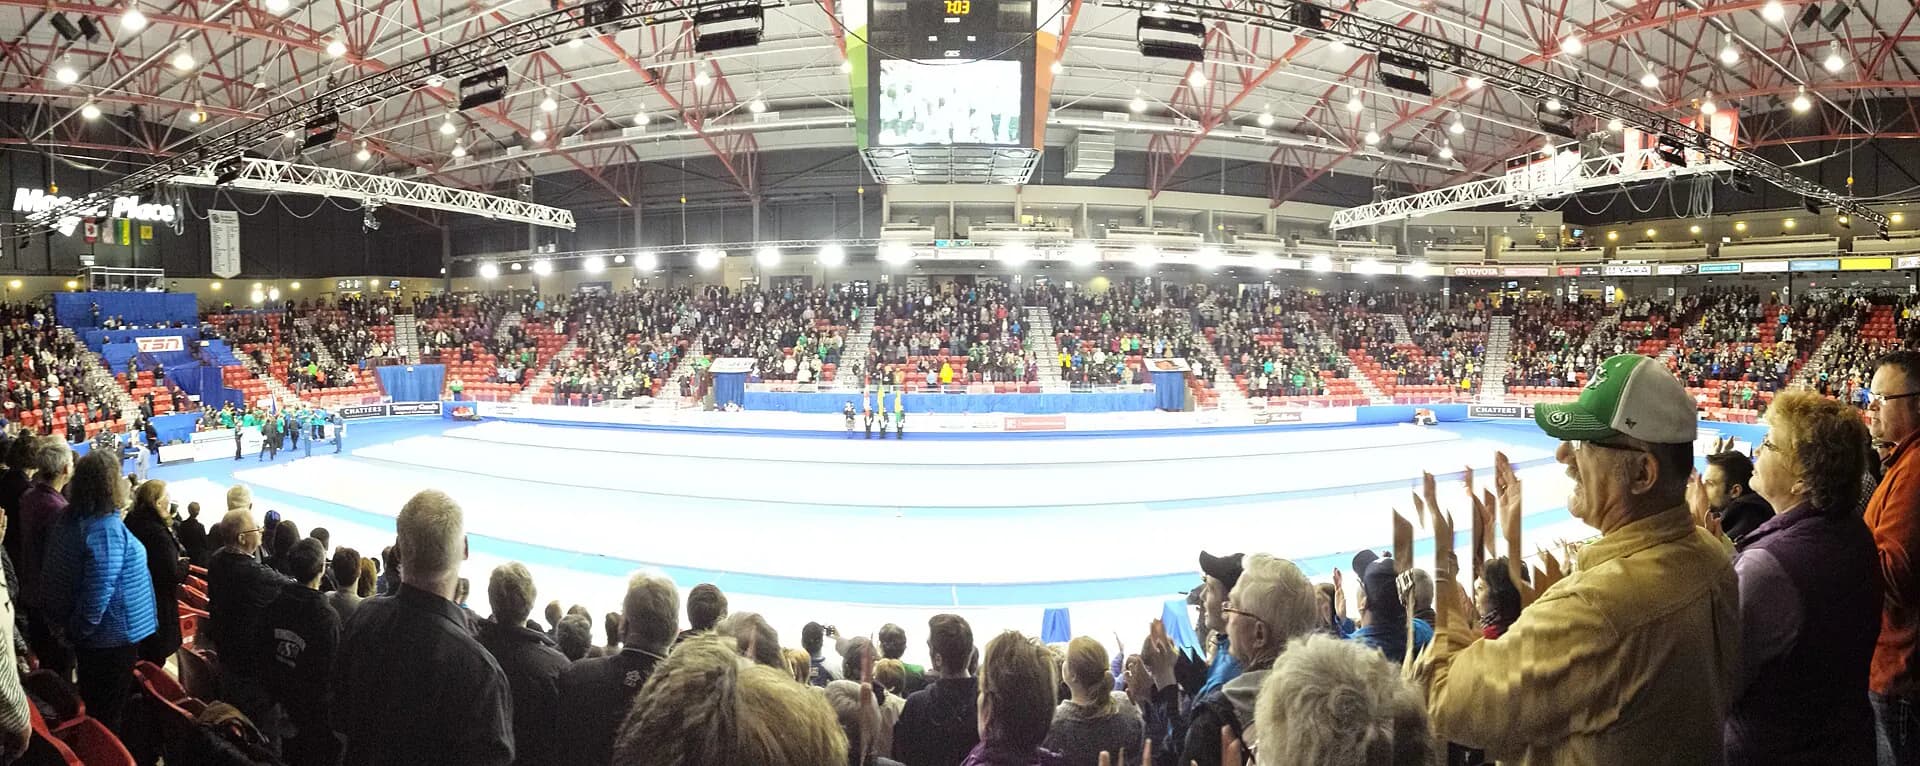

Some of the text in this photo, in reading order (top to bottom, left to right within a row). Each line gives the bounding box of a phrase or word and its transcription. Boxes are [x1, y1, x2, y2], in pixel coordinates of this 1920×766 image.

[944, 0, 970, 14] 7:03
[112, 195, 175, 222] Place
[1467, 267, 1498, 276] TOYOTA
[1556, 288, 1563, 296] D
[1668, 287, 1675, 296] D
[1909, 284, 1916, 294] B
[140, 338, 179, 350] TSN
[344, 405, 382, 415] CHATTERS
[1475, 406, 1517, 414] CHATTERS
